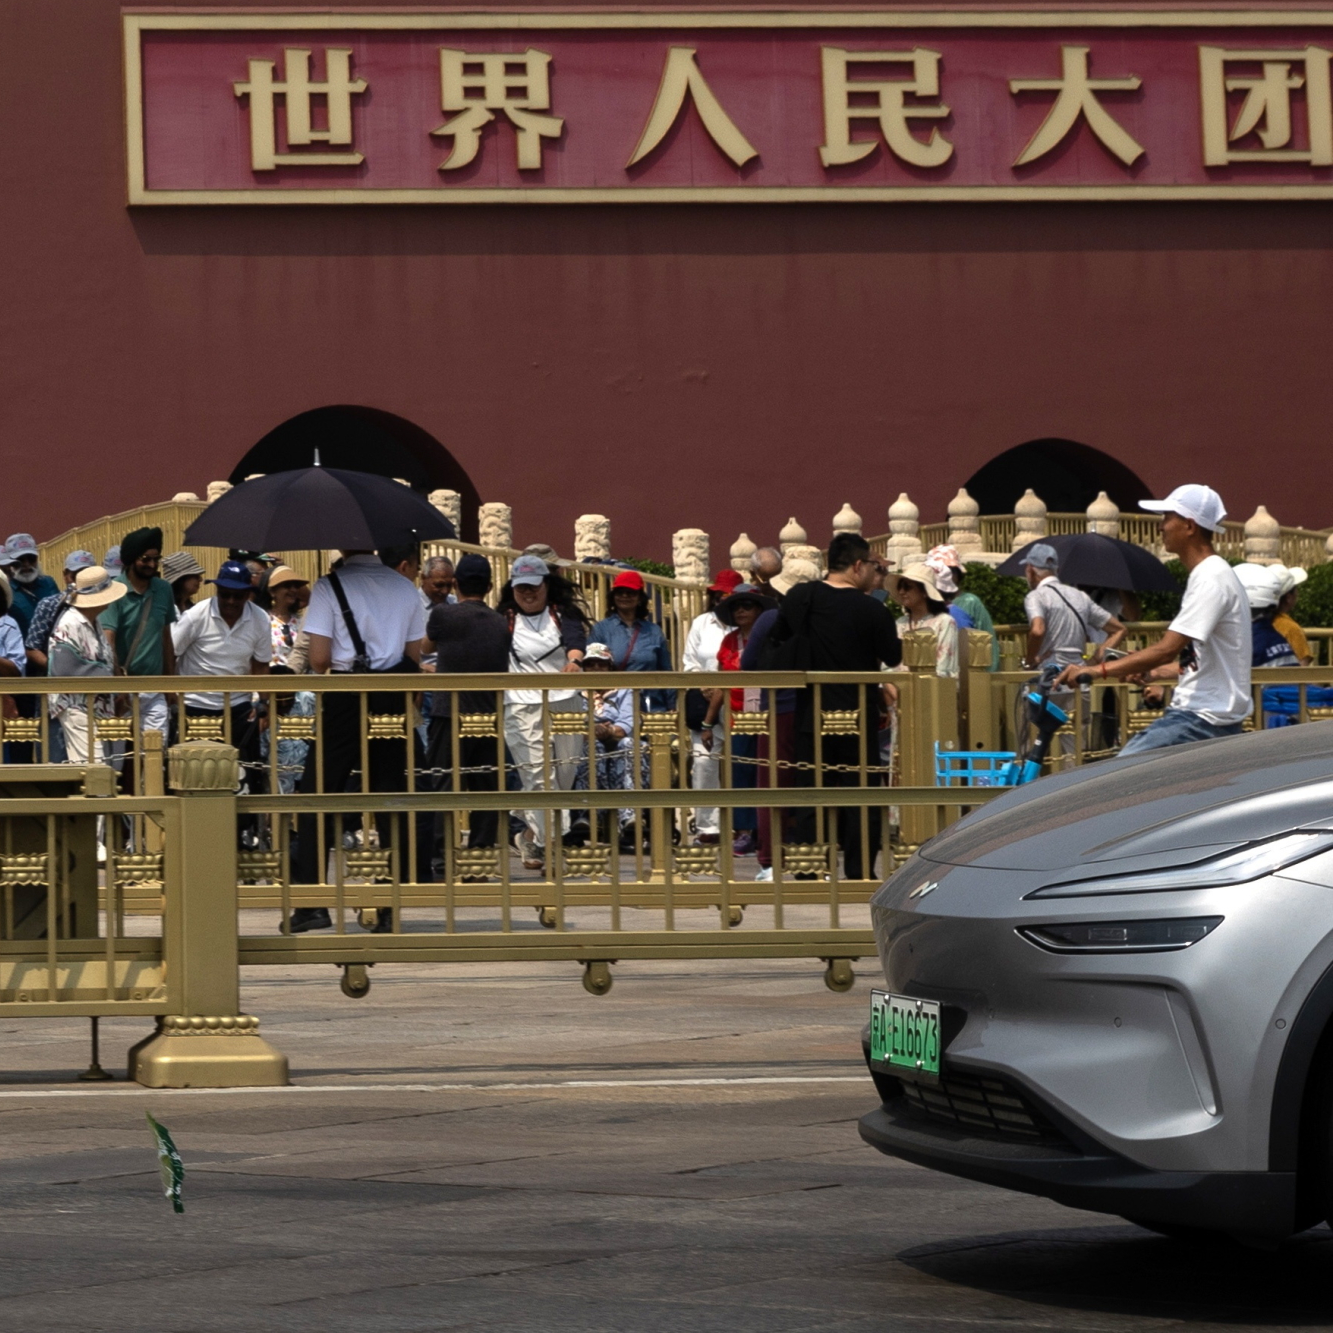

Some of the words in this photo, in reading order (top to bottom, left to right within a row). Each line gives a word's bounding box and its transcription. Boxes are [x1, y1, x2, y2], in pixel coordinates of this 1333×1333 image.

[233, 44, 1333, 172] 世界人民大团
